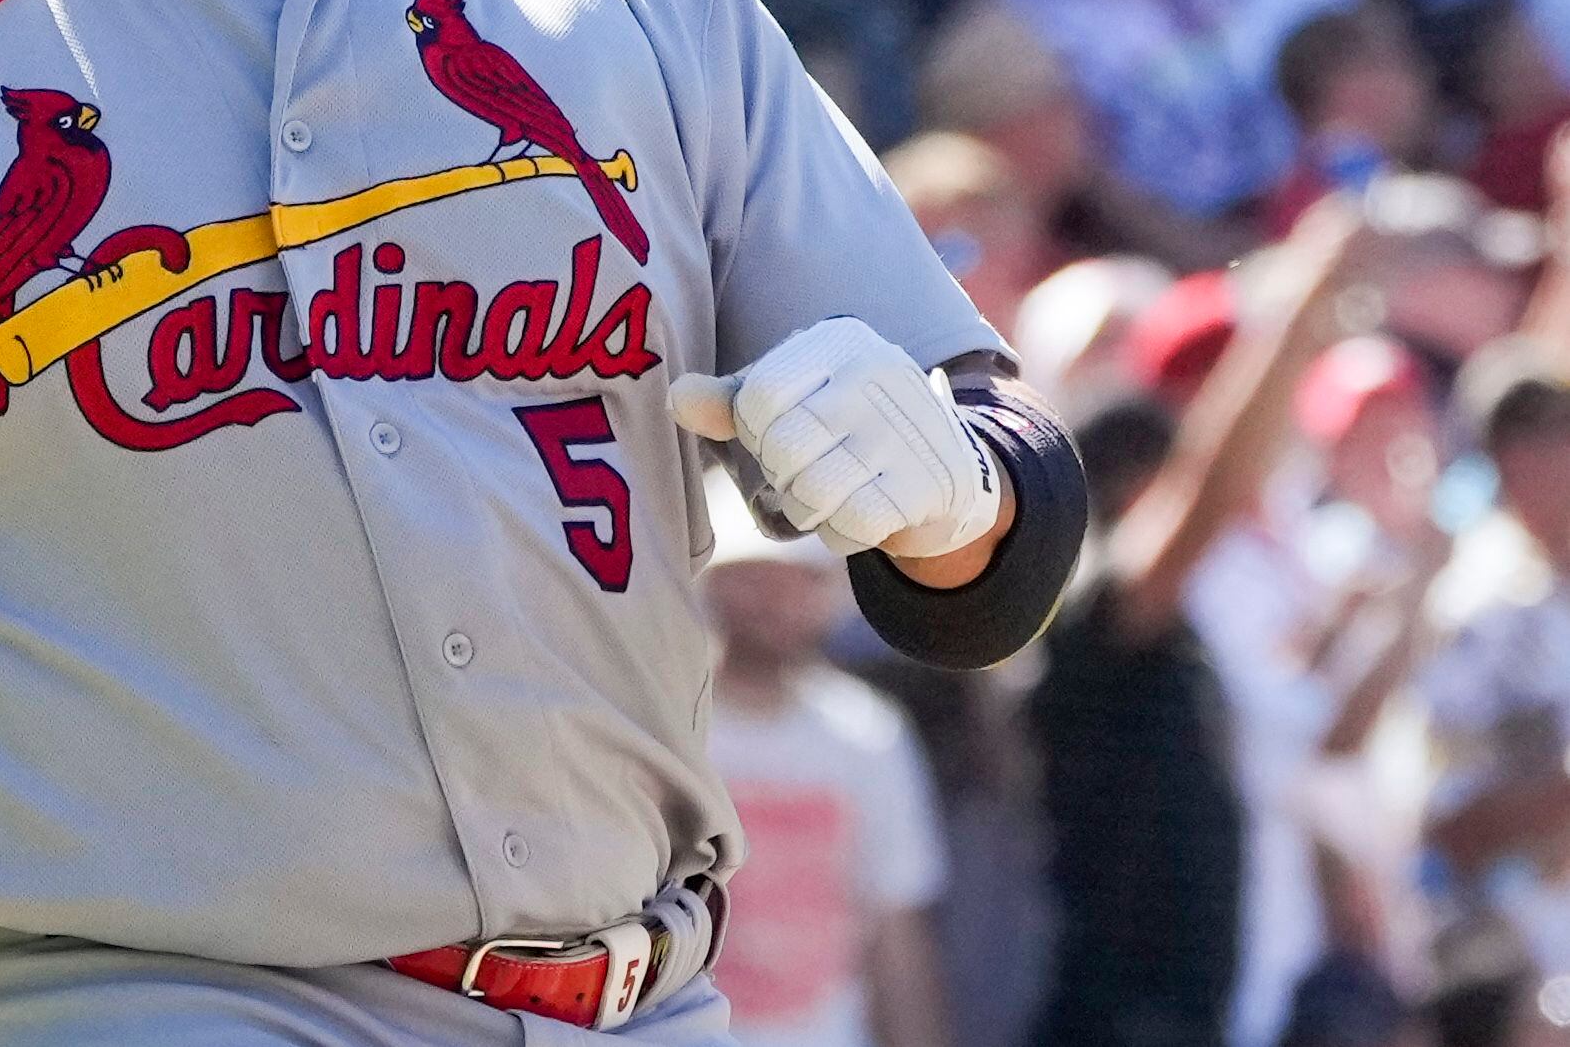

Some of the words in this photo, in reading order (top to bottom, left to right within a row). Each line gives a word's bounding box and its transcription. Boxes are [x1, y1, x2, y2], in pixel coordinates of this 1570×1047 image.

[65, 223, 663, 452] Cardinals
[513, 395, 634, 594] 5
[617, 958, 640, 1013] 5
